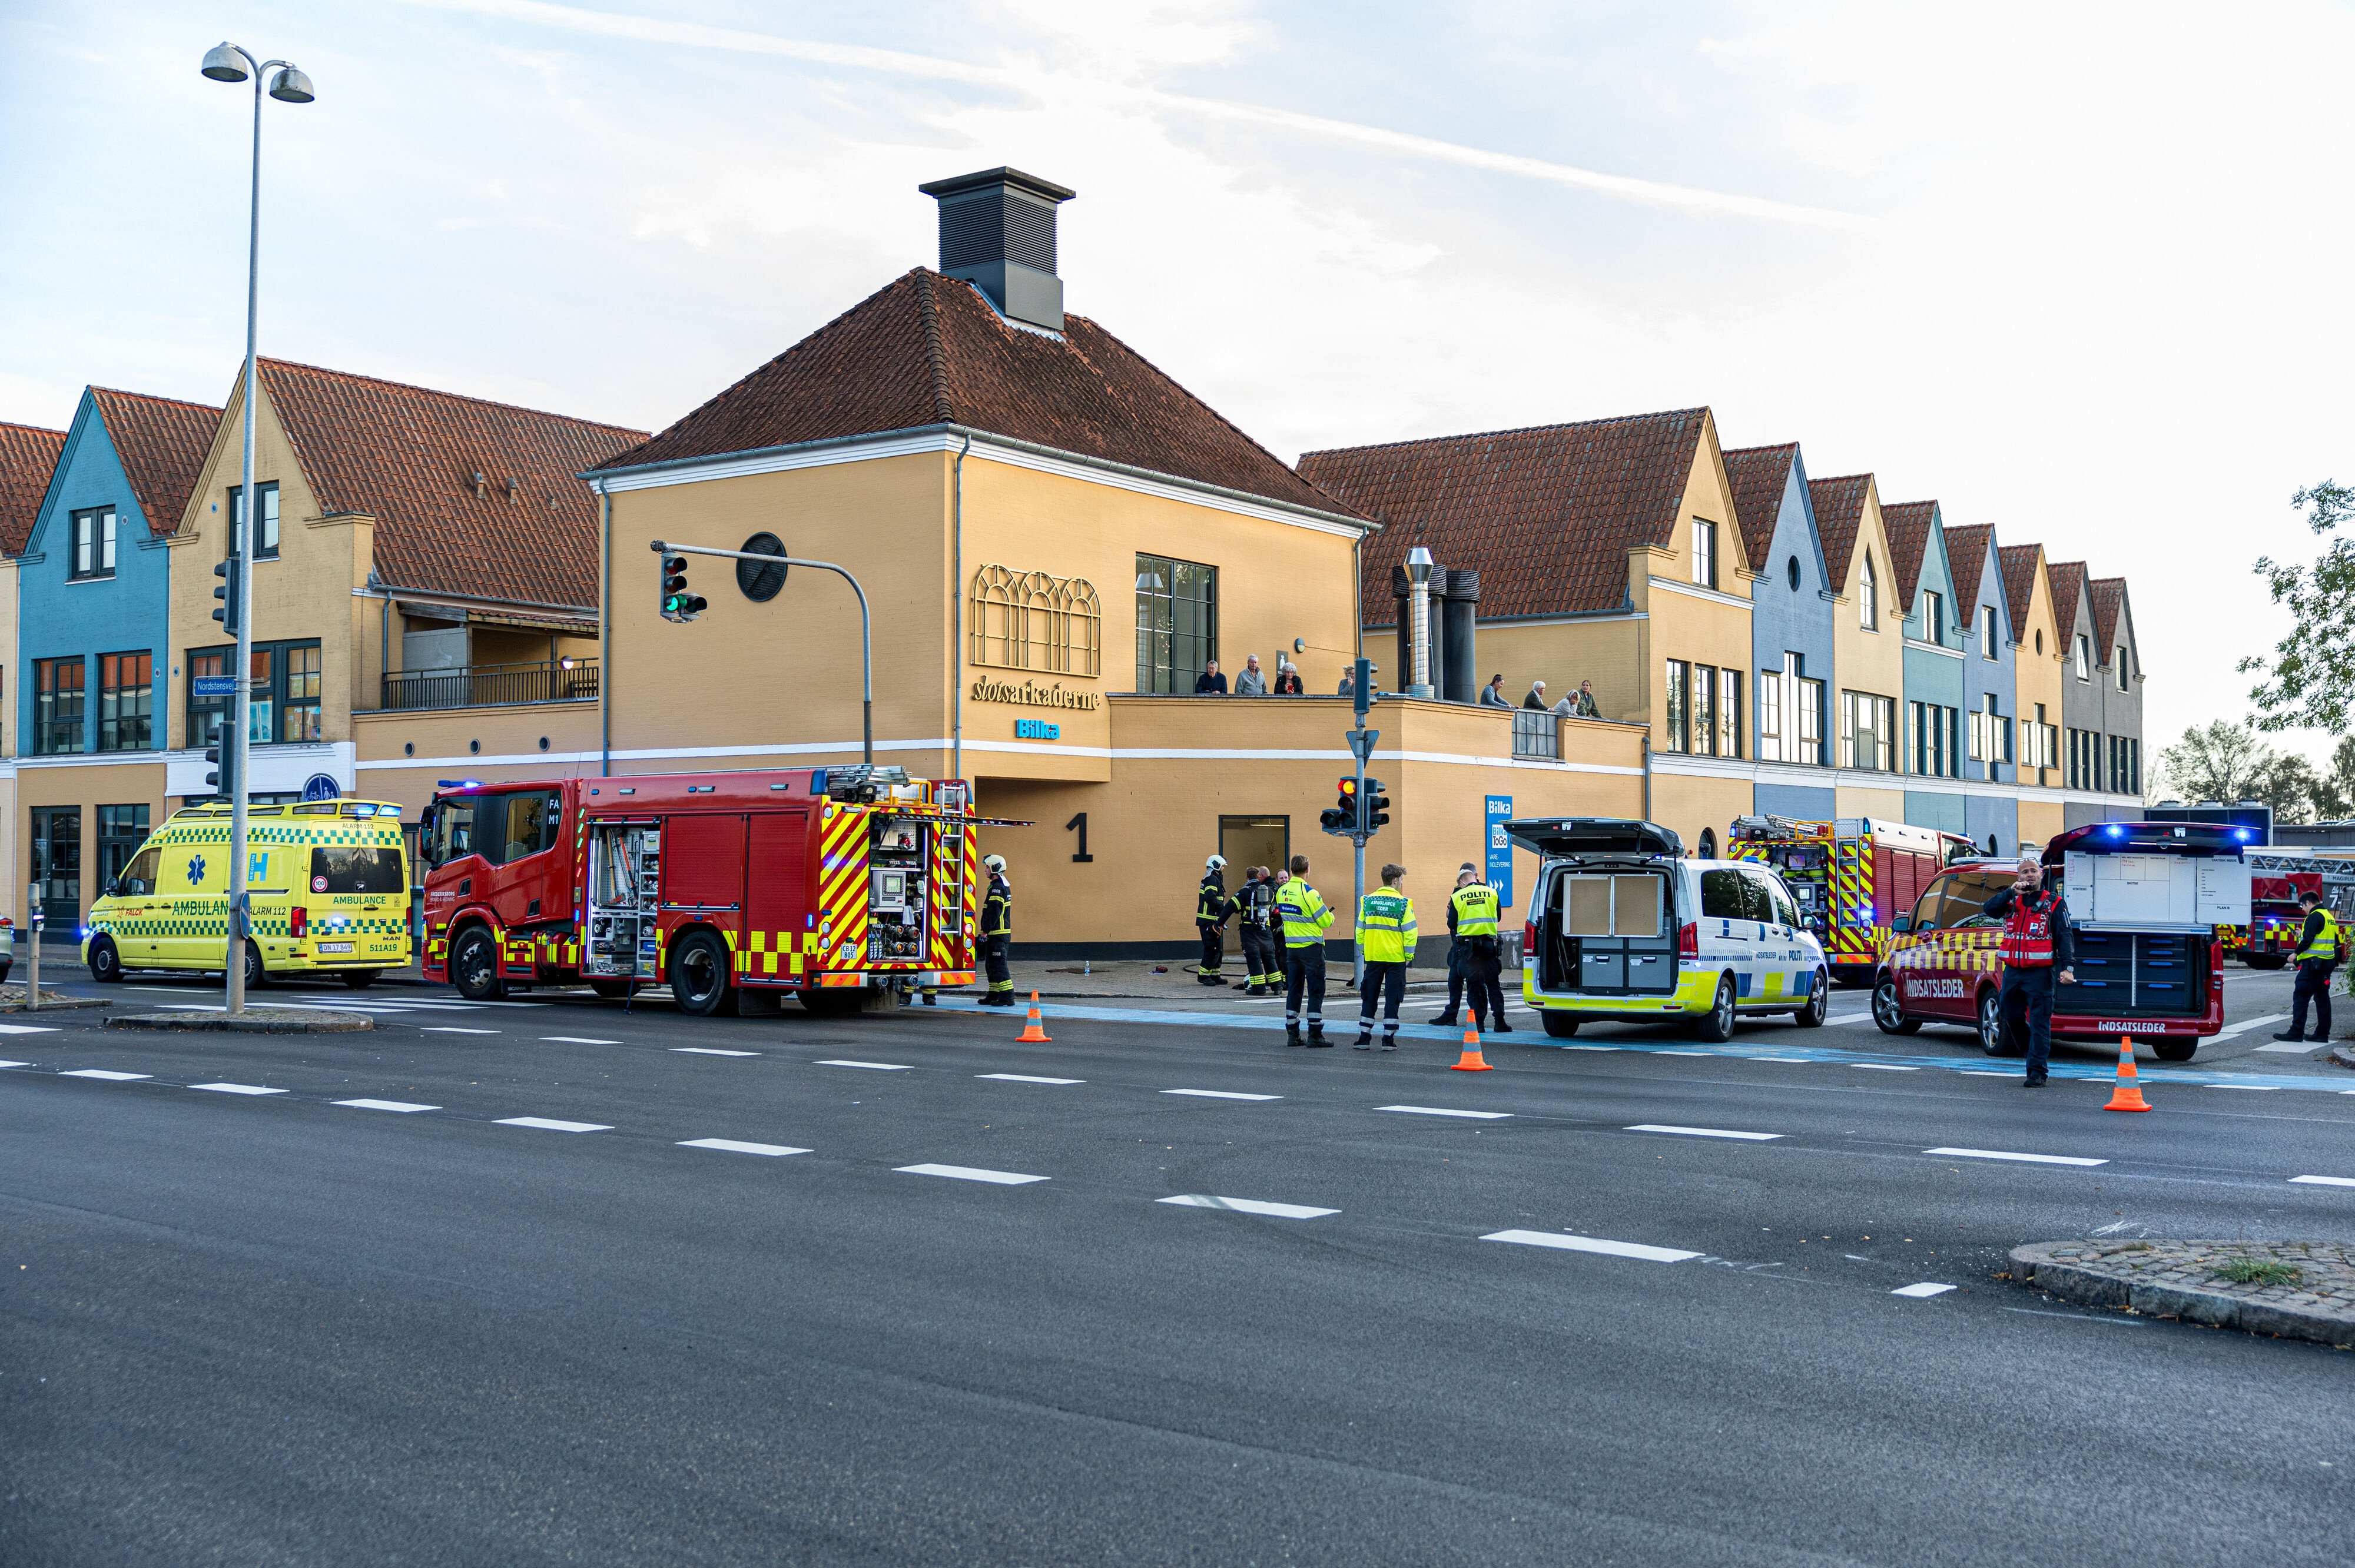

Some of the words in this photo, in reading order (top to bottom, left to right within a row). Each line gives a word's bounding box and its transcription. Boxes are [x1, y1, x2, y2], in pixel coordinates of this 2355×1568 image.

[197, 681, 234, 692] Nordstensvej
[973, 674, 1100, 710] slotsarkaderne
[1016, 719, 1060, 739] Bilka
[549, 799, 559, 809] FA
[1488, 800, 1511, 814] Bilka
[549, 815, 559, 824] M1
[1066, 812, 1093, 862] 1
[1492, 835, 1507, 846] ToGo
[333, 896, 386, 904] AMBULANCE
[1460, 891, 1491, 901] POLITI
[172, 900, 229, 916] AMBULAN
[249, 907, 272, 915] ALARM
[273, 907, 286, 915] 112
[369, 944, 397, 952] 511A19
[1789, 950, 1802, 961] POLITI
[1906, 979, 1964, 998] INDSATSLEDER
[2098, 1021, 2166, 1033] INDSATSLEDER
